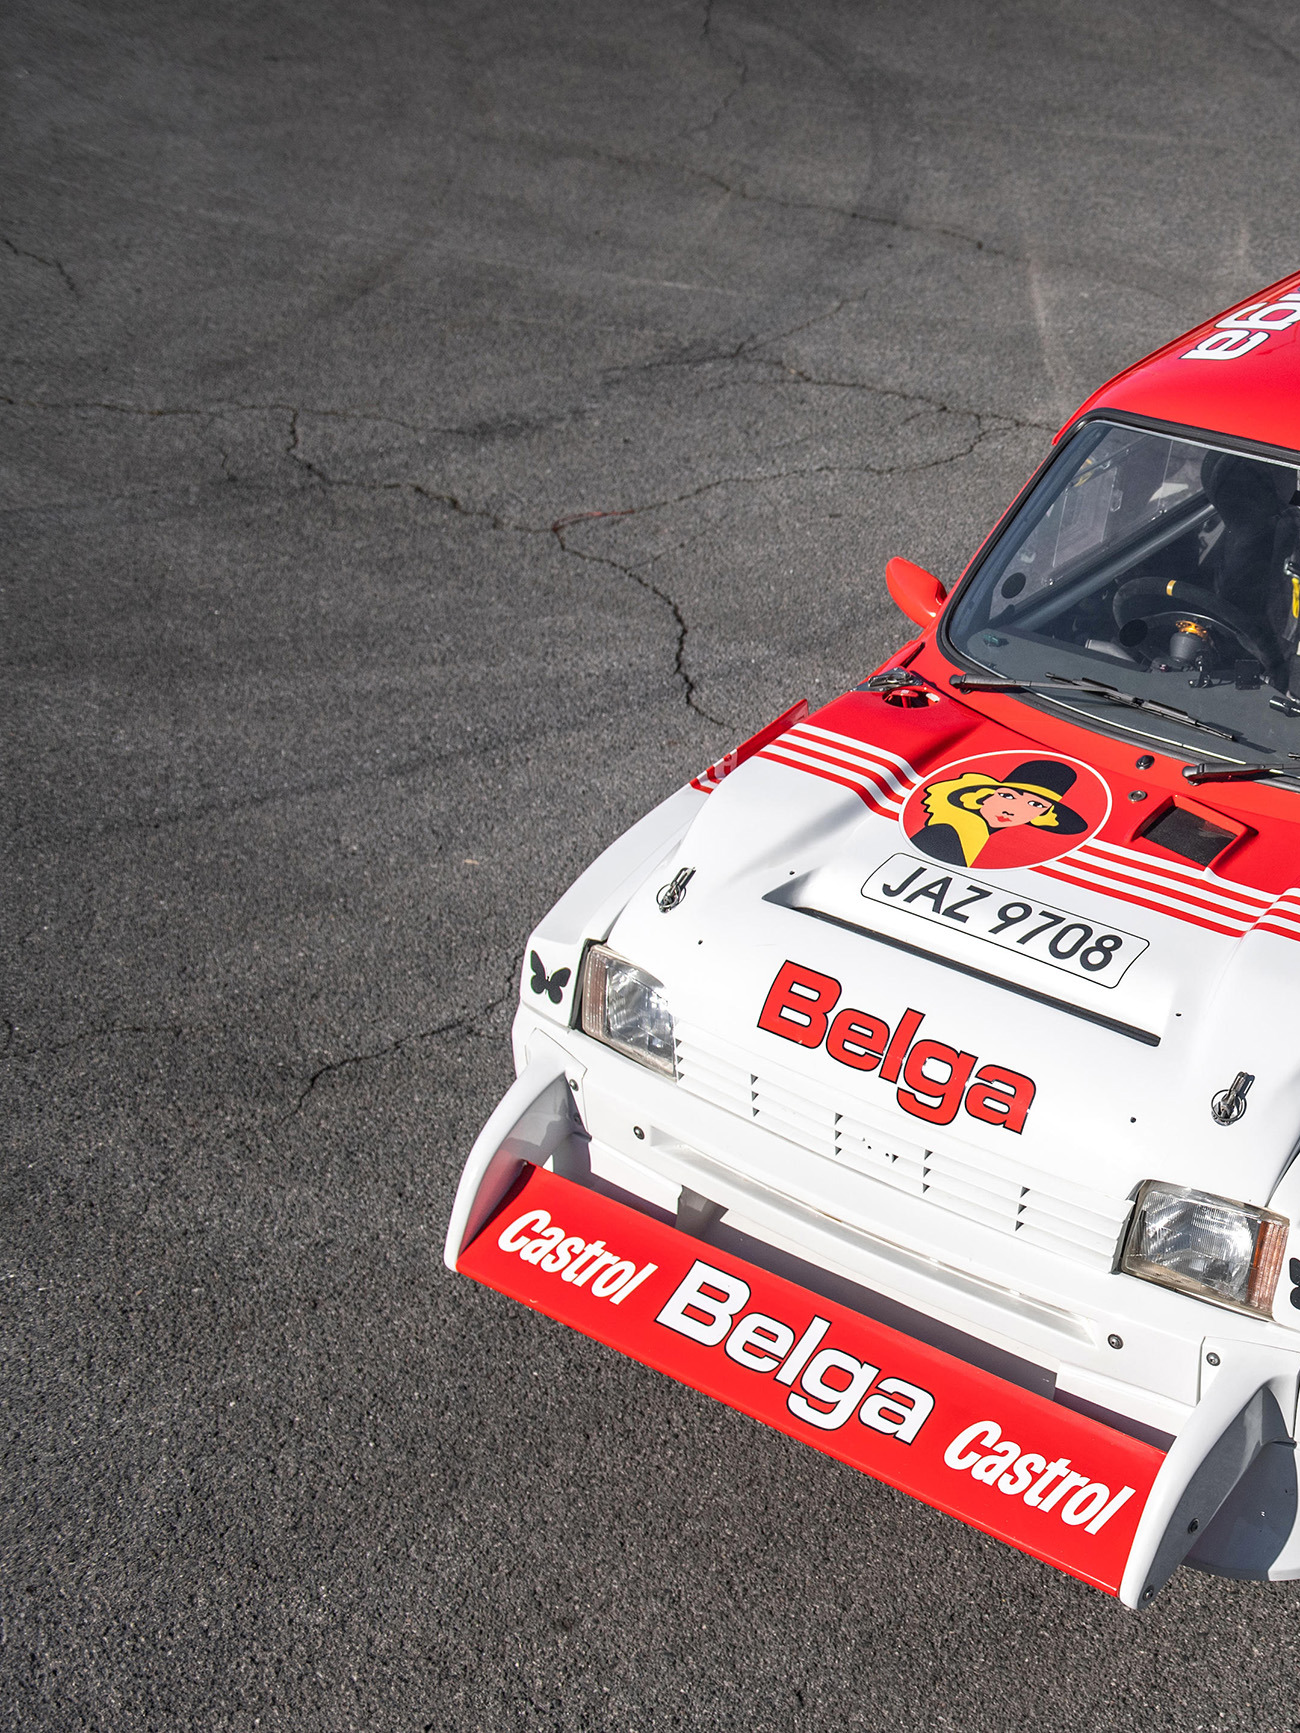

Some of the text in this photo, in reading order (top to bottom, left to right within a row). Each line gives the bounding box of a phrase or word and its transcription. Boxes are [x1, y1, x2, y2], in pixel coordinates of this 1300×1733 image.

[881, 867, 1124, 973] JAZ 9708
[757, 959, 1037, 1135] Belga
[497, 1209, 658, 1306] Castrol
[654, 1260, 935, 1446] Belga
[943, 1420, 1136, 1536] Castrol
